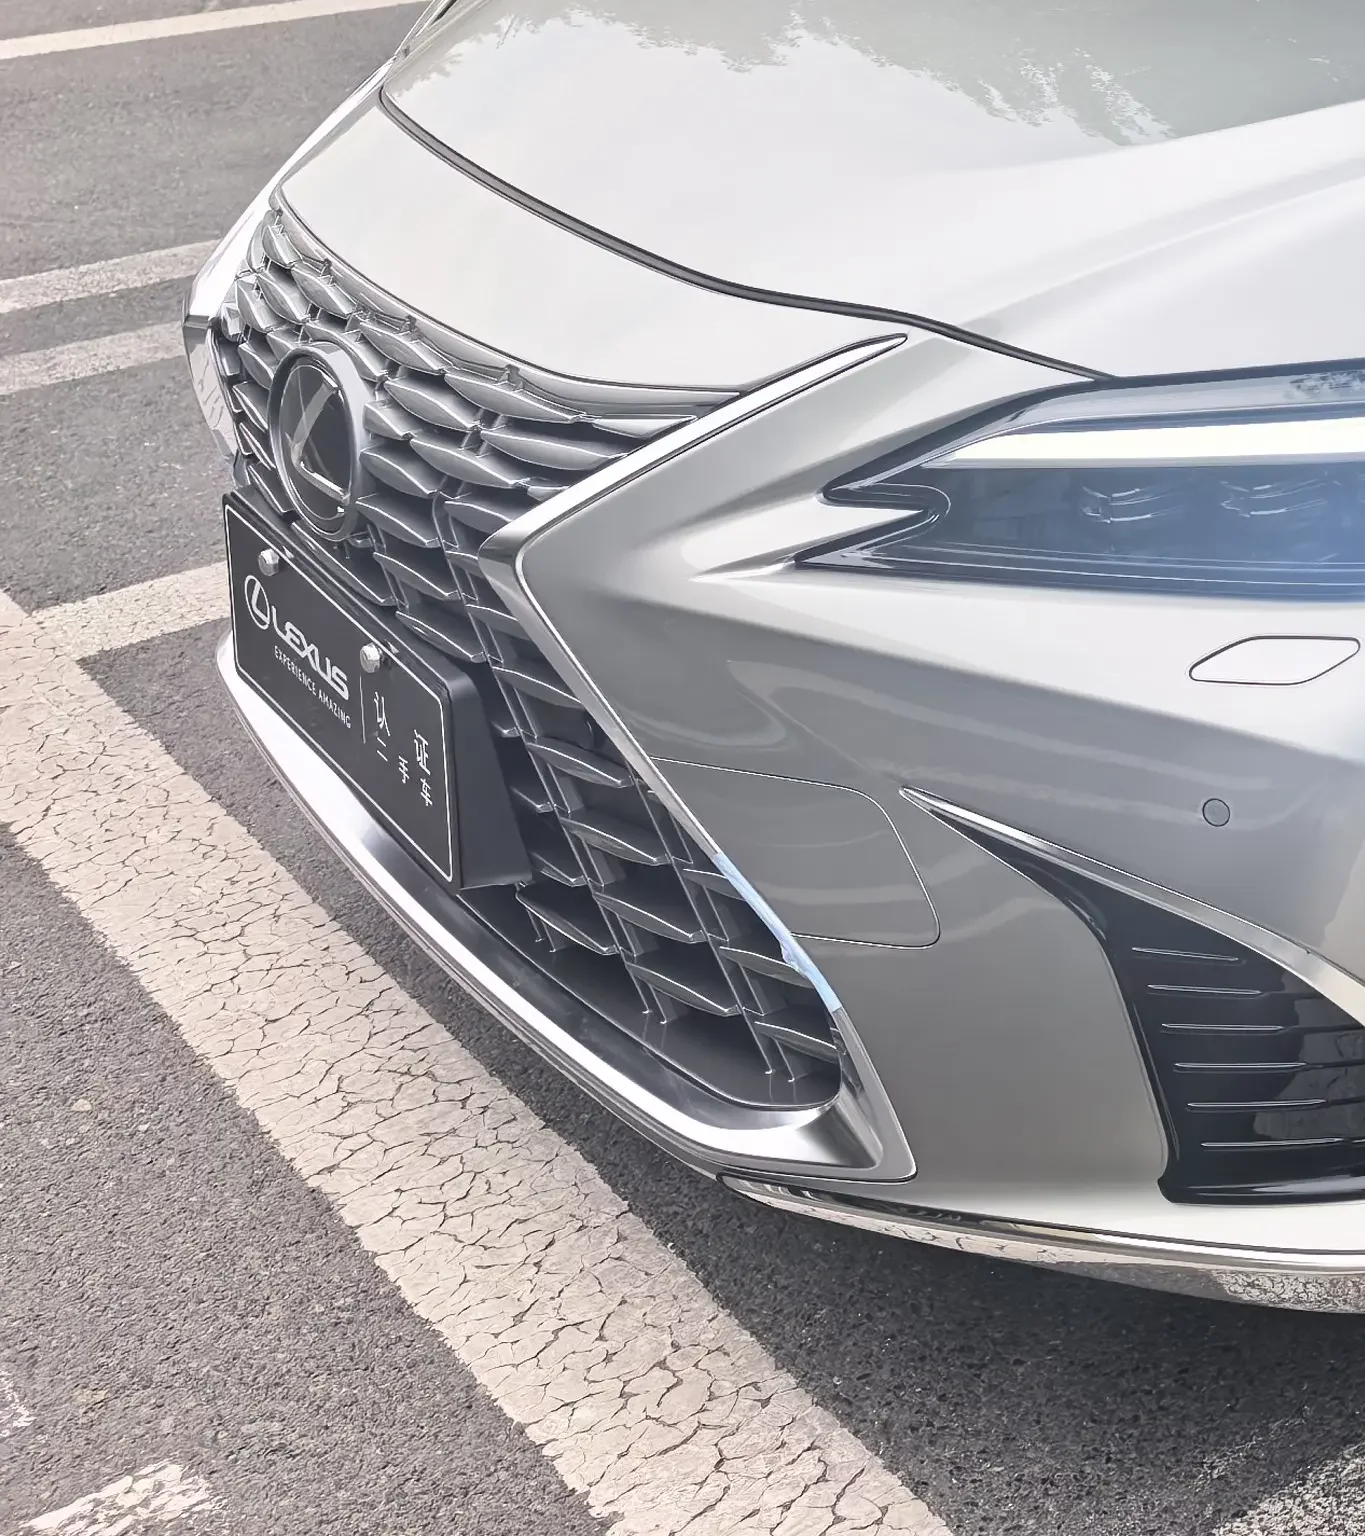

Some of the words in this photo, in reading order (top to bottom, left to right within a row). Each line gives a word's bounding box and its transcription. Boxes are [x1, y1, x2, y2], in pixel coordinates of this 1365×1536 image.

[271, 604, 350, 701] LEXUS
[274, 644, 317, 695] EXPERIENCE
[318, 689, 351, 729] AMAZING
